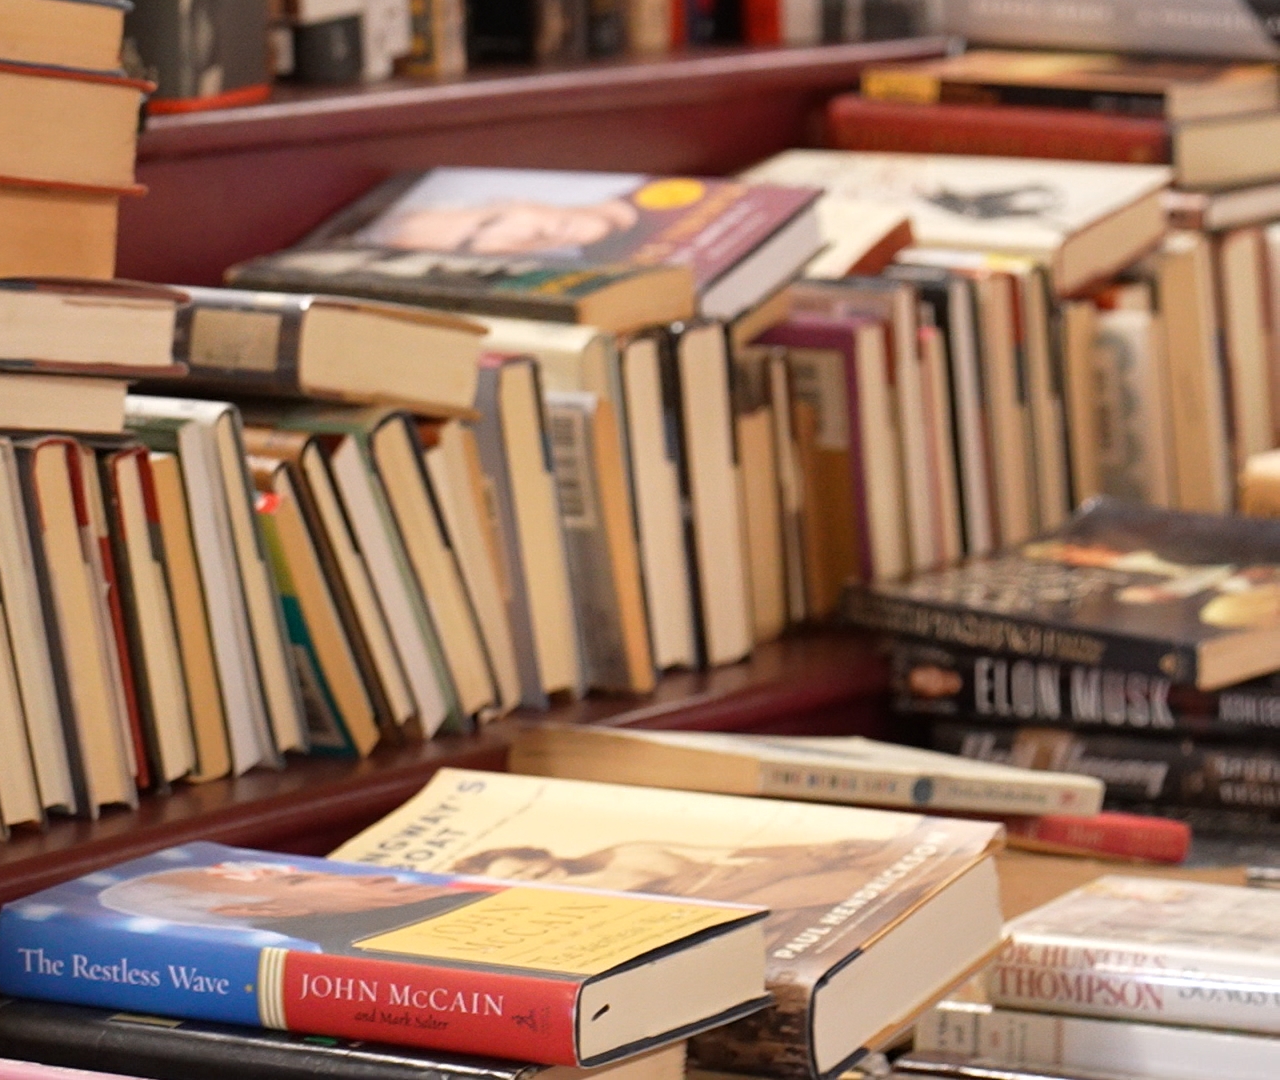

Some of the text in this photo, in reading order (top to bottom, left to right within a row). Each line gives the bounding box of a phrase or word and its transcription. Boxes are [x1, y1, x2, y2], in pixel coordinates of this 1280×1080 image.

[975, 658, 1061, 718] ELON
[1070, 666, 1174, 728] MUSK
[774, 923, 828, 961] PAUL
[18, 947, 231, 996] The Restless Wave
[996, 967, 1165, 1011] THOMPSON
[300, 973, 505, 1018] JOHN McCAIN
